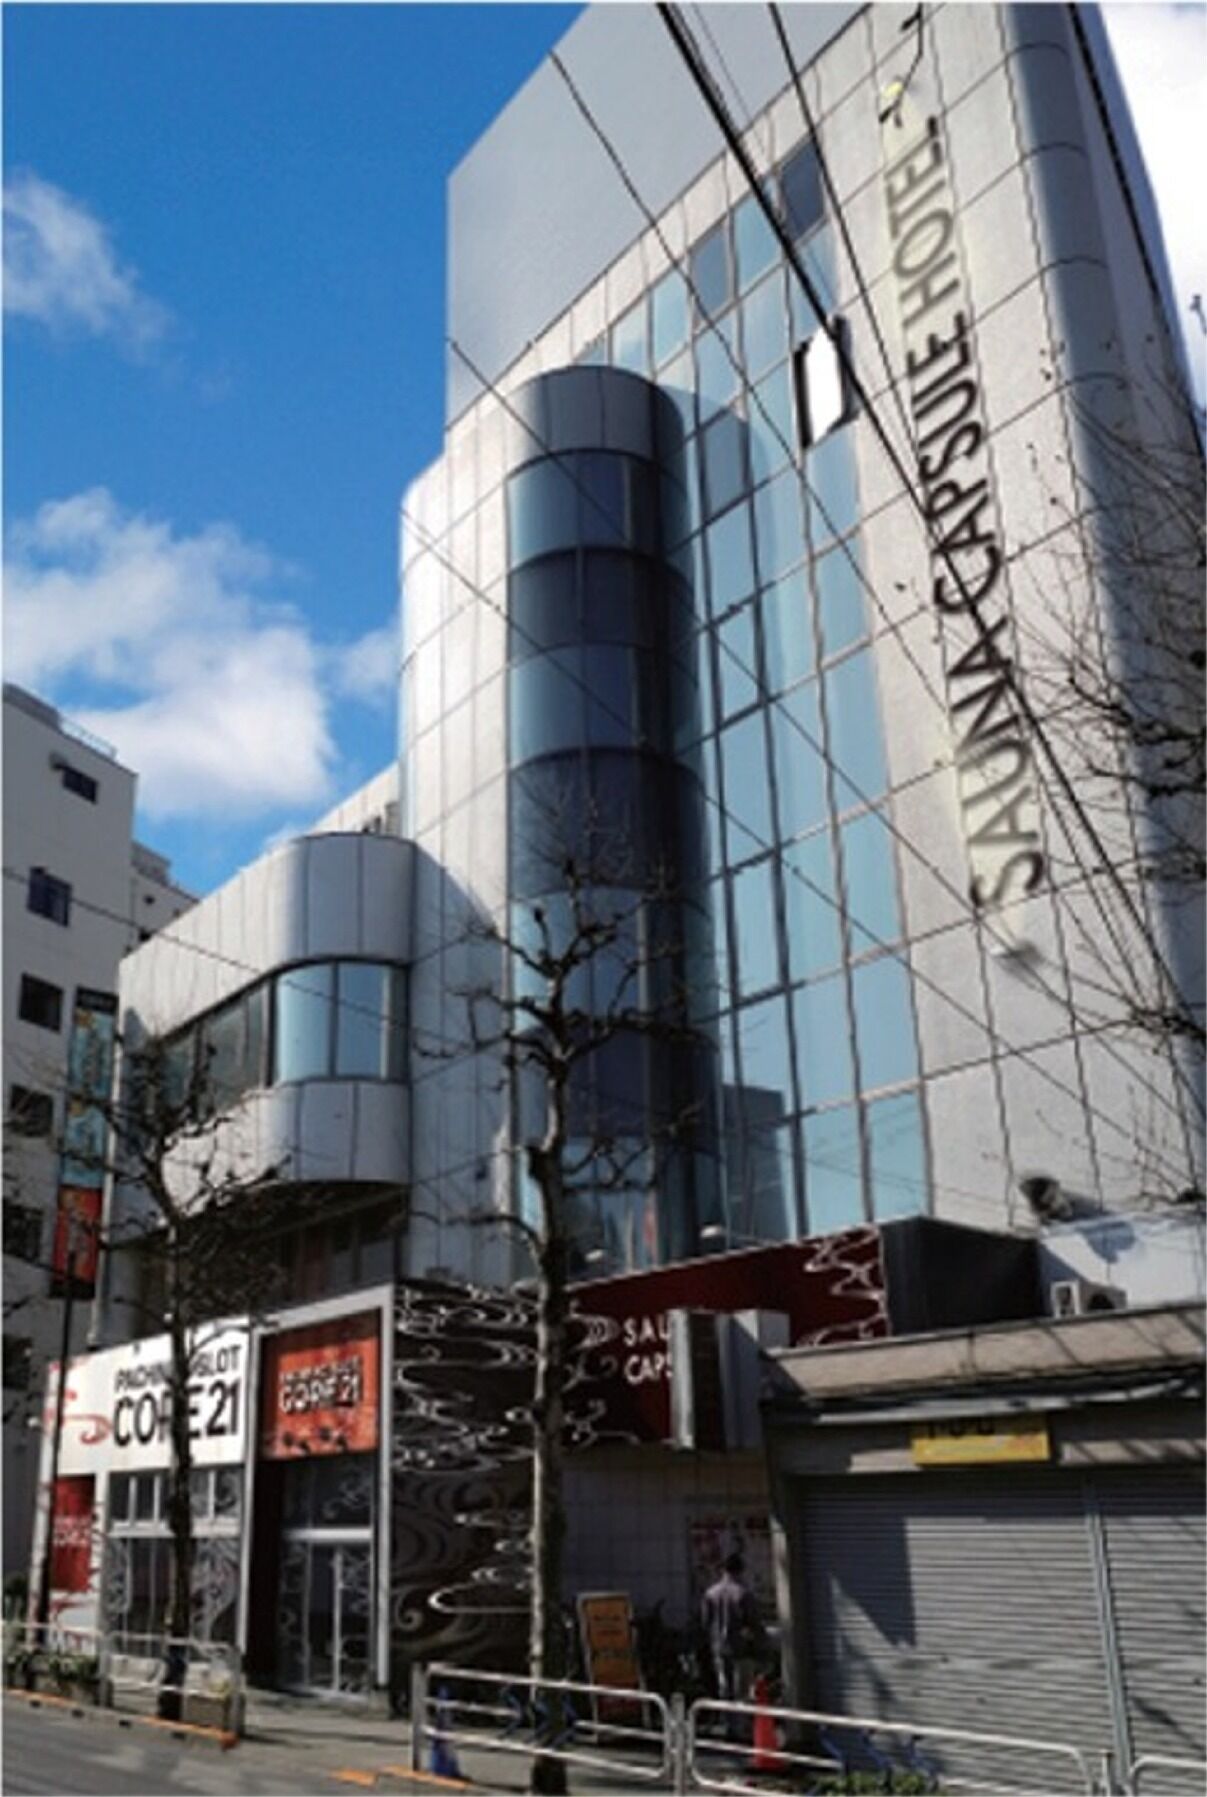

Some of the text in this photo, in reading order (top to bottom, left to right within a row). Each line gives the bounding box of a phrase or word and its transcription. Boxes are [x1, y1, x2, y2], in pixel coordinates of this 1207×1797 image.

[884, 115, 1044, 906] SAUNA CAPSULE HOTEL
[623, 1314, 672, 1347] SAU
[623, 1351, 673, 1386] CAPS
